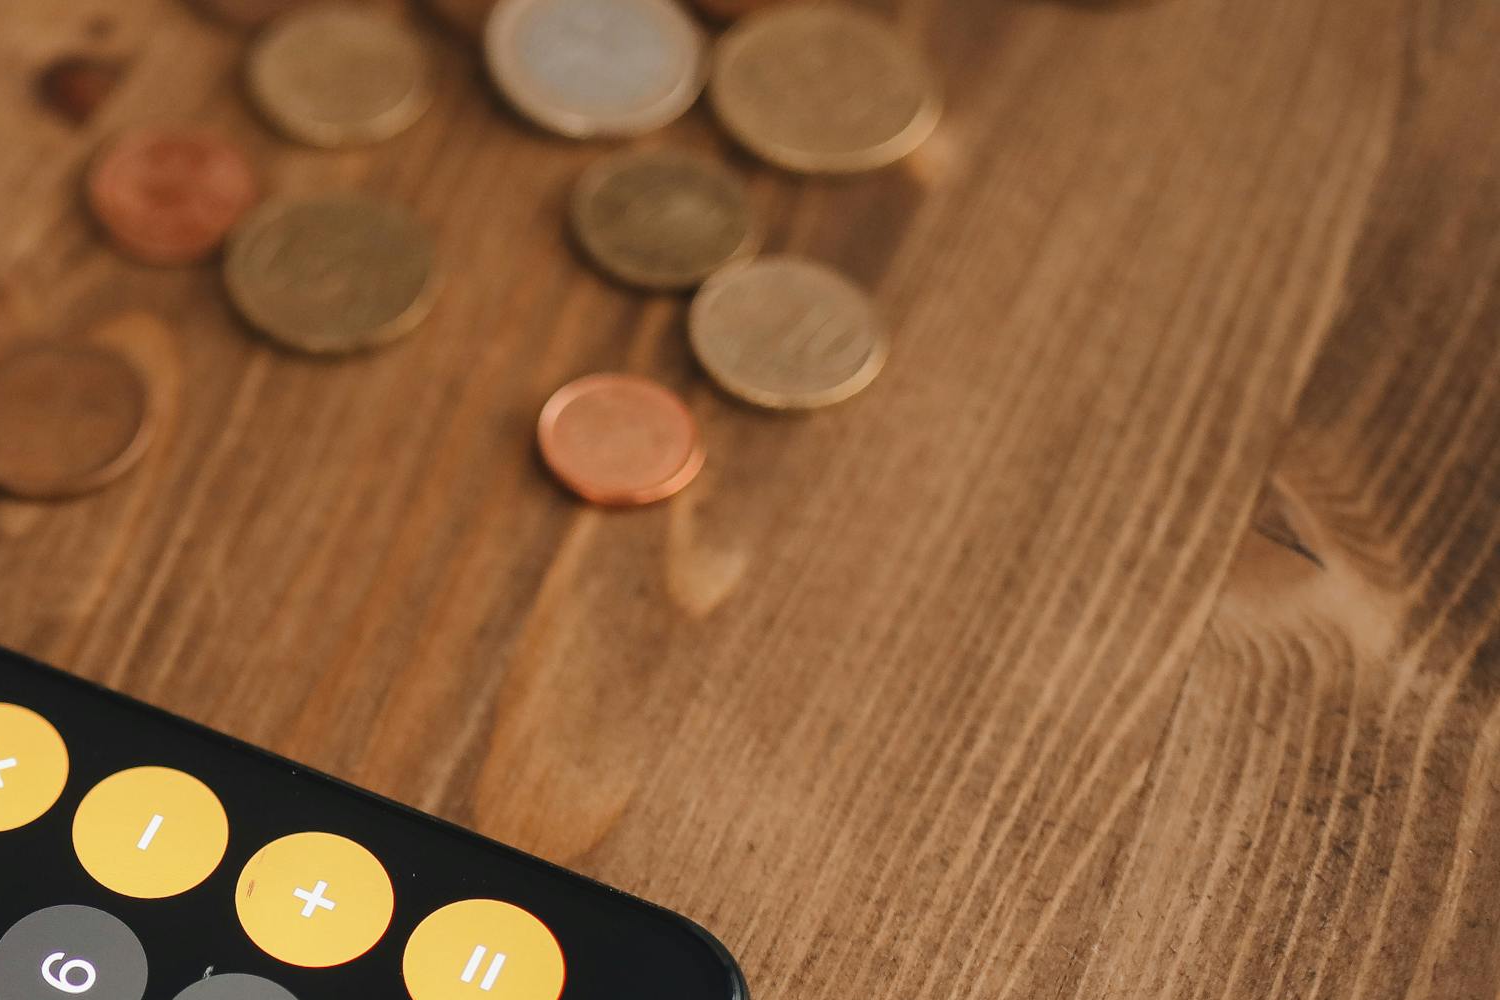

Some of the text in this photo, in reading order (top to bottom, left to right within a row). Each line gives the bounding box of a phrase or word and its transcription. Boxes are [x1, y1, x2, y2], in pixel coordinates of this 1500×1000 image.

[293, 880, 336, 918] +
[41, 952, 97, 994] 6
[460, 944, 506, 991] =
